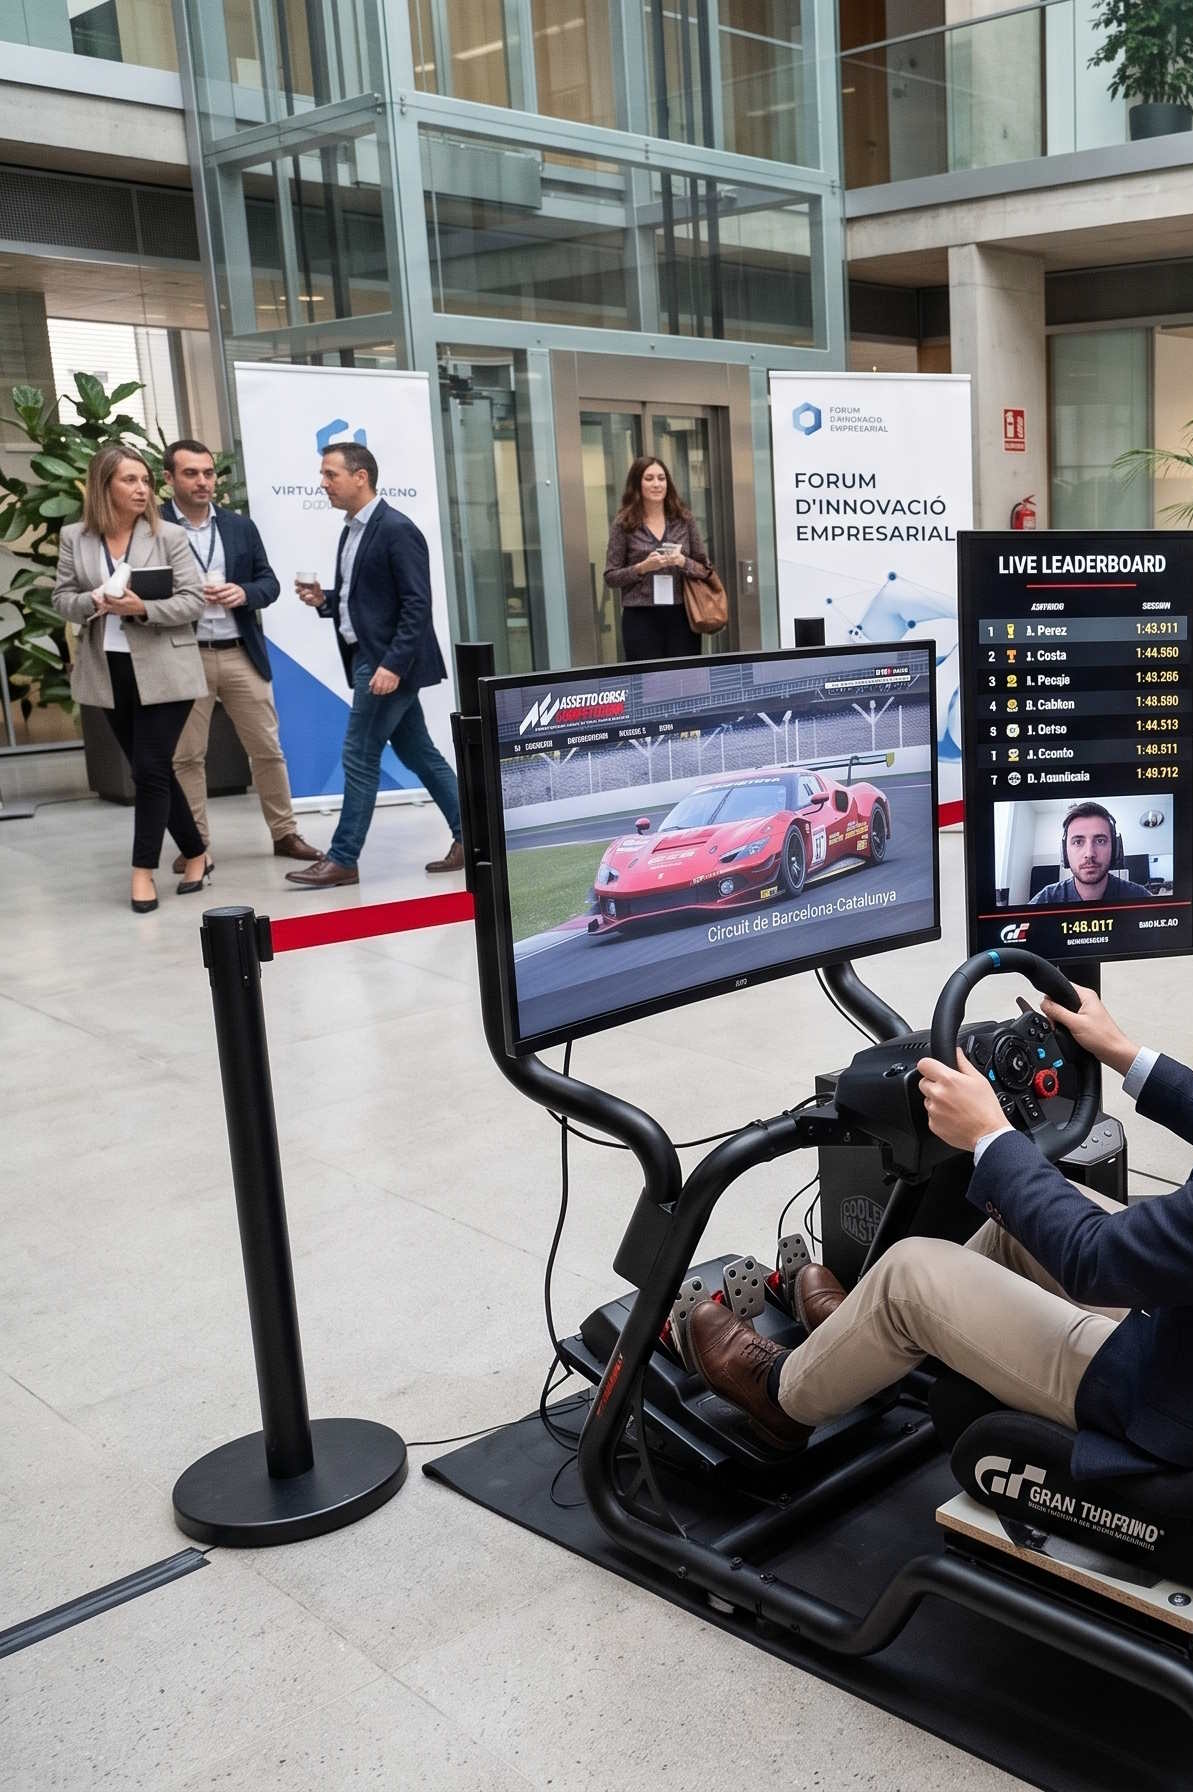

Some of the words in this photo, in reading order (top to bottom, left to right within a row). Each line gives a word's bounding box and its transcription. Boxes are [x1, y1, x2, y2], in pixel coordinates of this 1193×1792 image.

[795, 473, 876, 489] FORUM
[796, 496, 946, 515] D'INNOVACIÓ
[796, 525, 956, 542] EMPRESARIAL
[999, 556, 1038, 574] LIVE
[1042, 554, 1167, 574] LEADERBOARD
[988, 627, 994, 637] 1
[1037, 625, 1068, 636] Perez
[1136, 623, 1178, 634] 1:43.911
[988, 651, 996, 662] 2
[1037, 650, 1067, 661] Costa
[988, 676, 996, 687] 3
[559, 693, 598, 709] ASSETTO
[598, 690, 626, 705] CORSA
[989, 701, 997, 712] 4
[708, 922, 750, 943] Circuit
[753, 915, 769, 931] de
[772, 890, 897, 926] Barcelona-Catalunya
[844, 1199, 884, 1223] COOLE
[1030, 1486, 1076, 1514] GRAN
